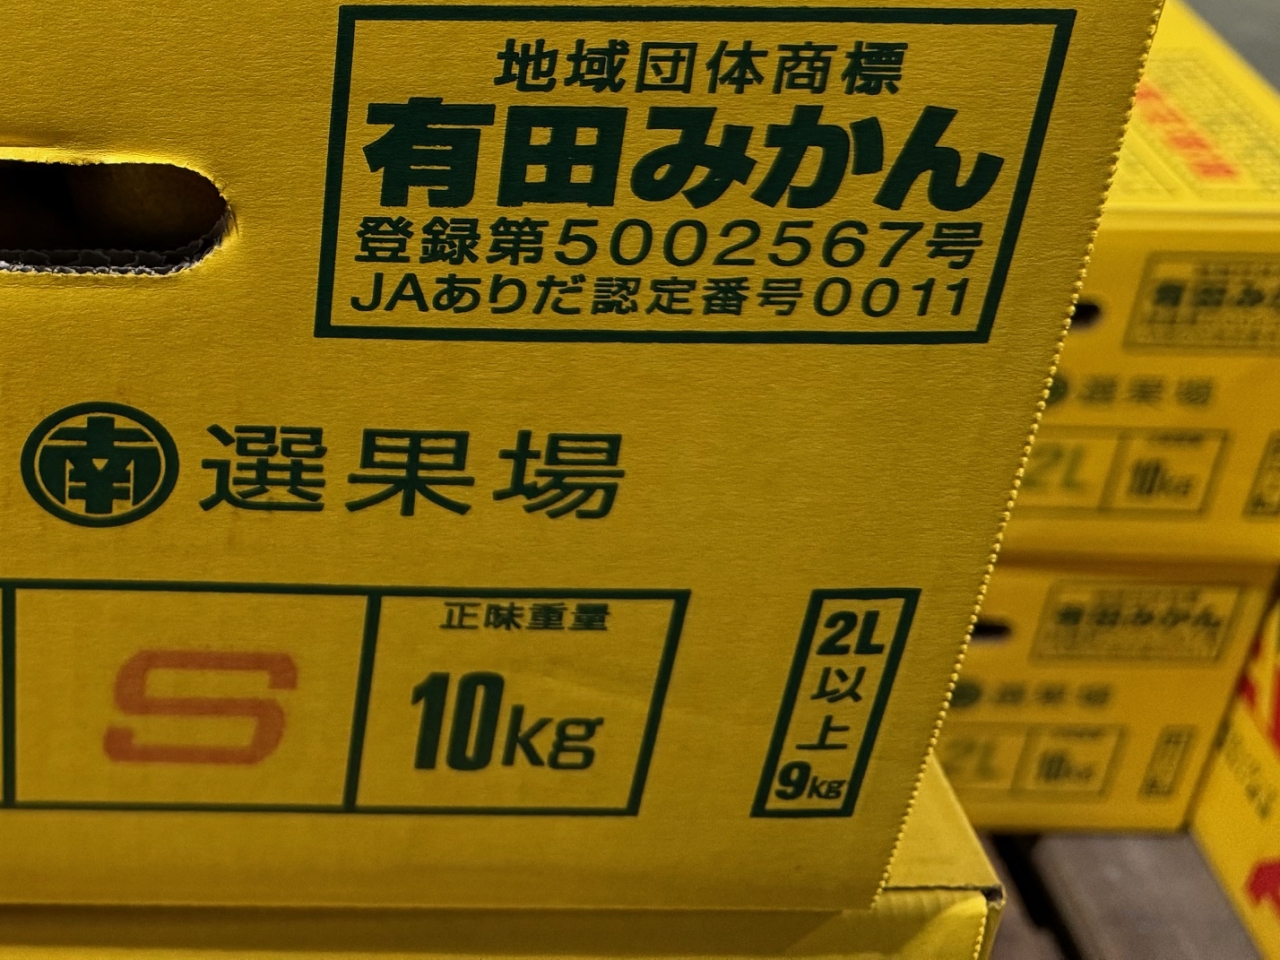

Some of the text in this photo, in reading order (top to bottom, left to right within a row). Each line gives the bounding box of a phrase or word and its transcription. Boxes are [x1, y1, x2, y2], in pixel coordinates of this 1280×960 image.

[495, 38, 909, 95] 地域団体商標
[363, 96, 1005, 212] 有田みかん
[355, 215, 984, 269] 登録第5002567号
[350, 271, 969, 318] JAありだ認定番号0011
[198, 423, 626, 520] 選果場
[438, 601, 612, 633] 正味重量
[822, 610, 888, 658] 2L
[103, 648, 299, 766] S
[411, 671, 605, 772] 10kg
[774, 759, 849, 805] 9kg
